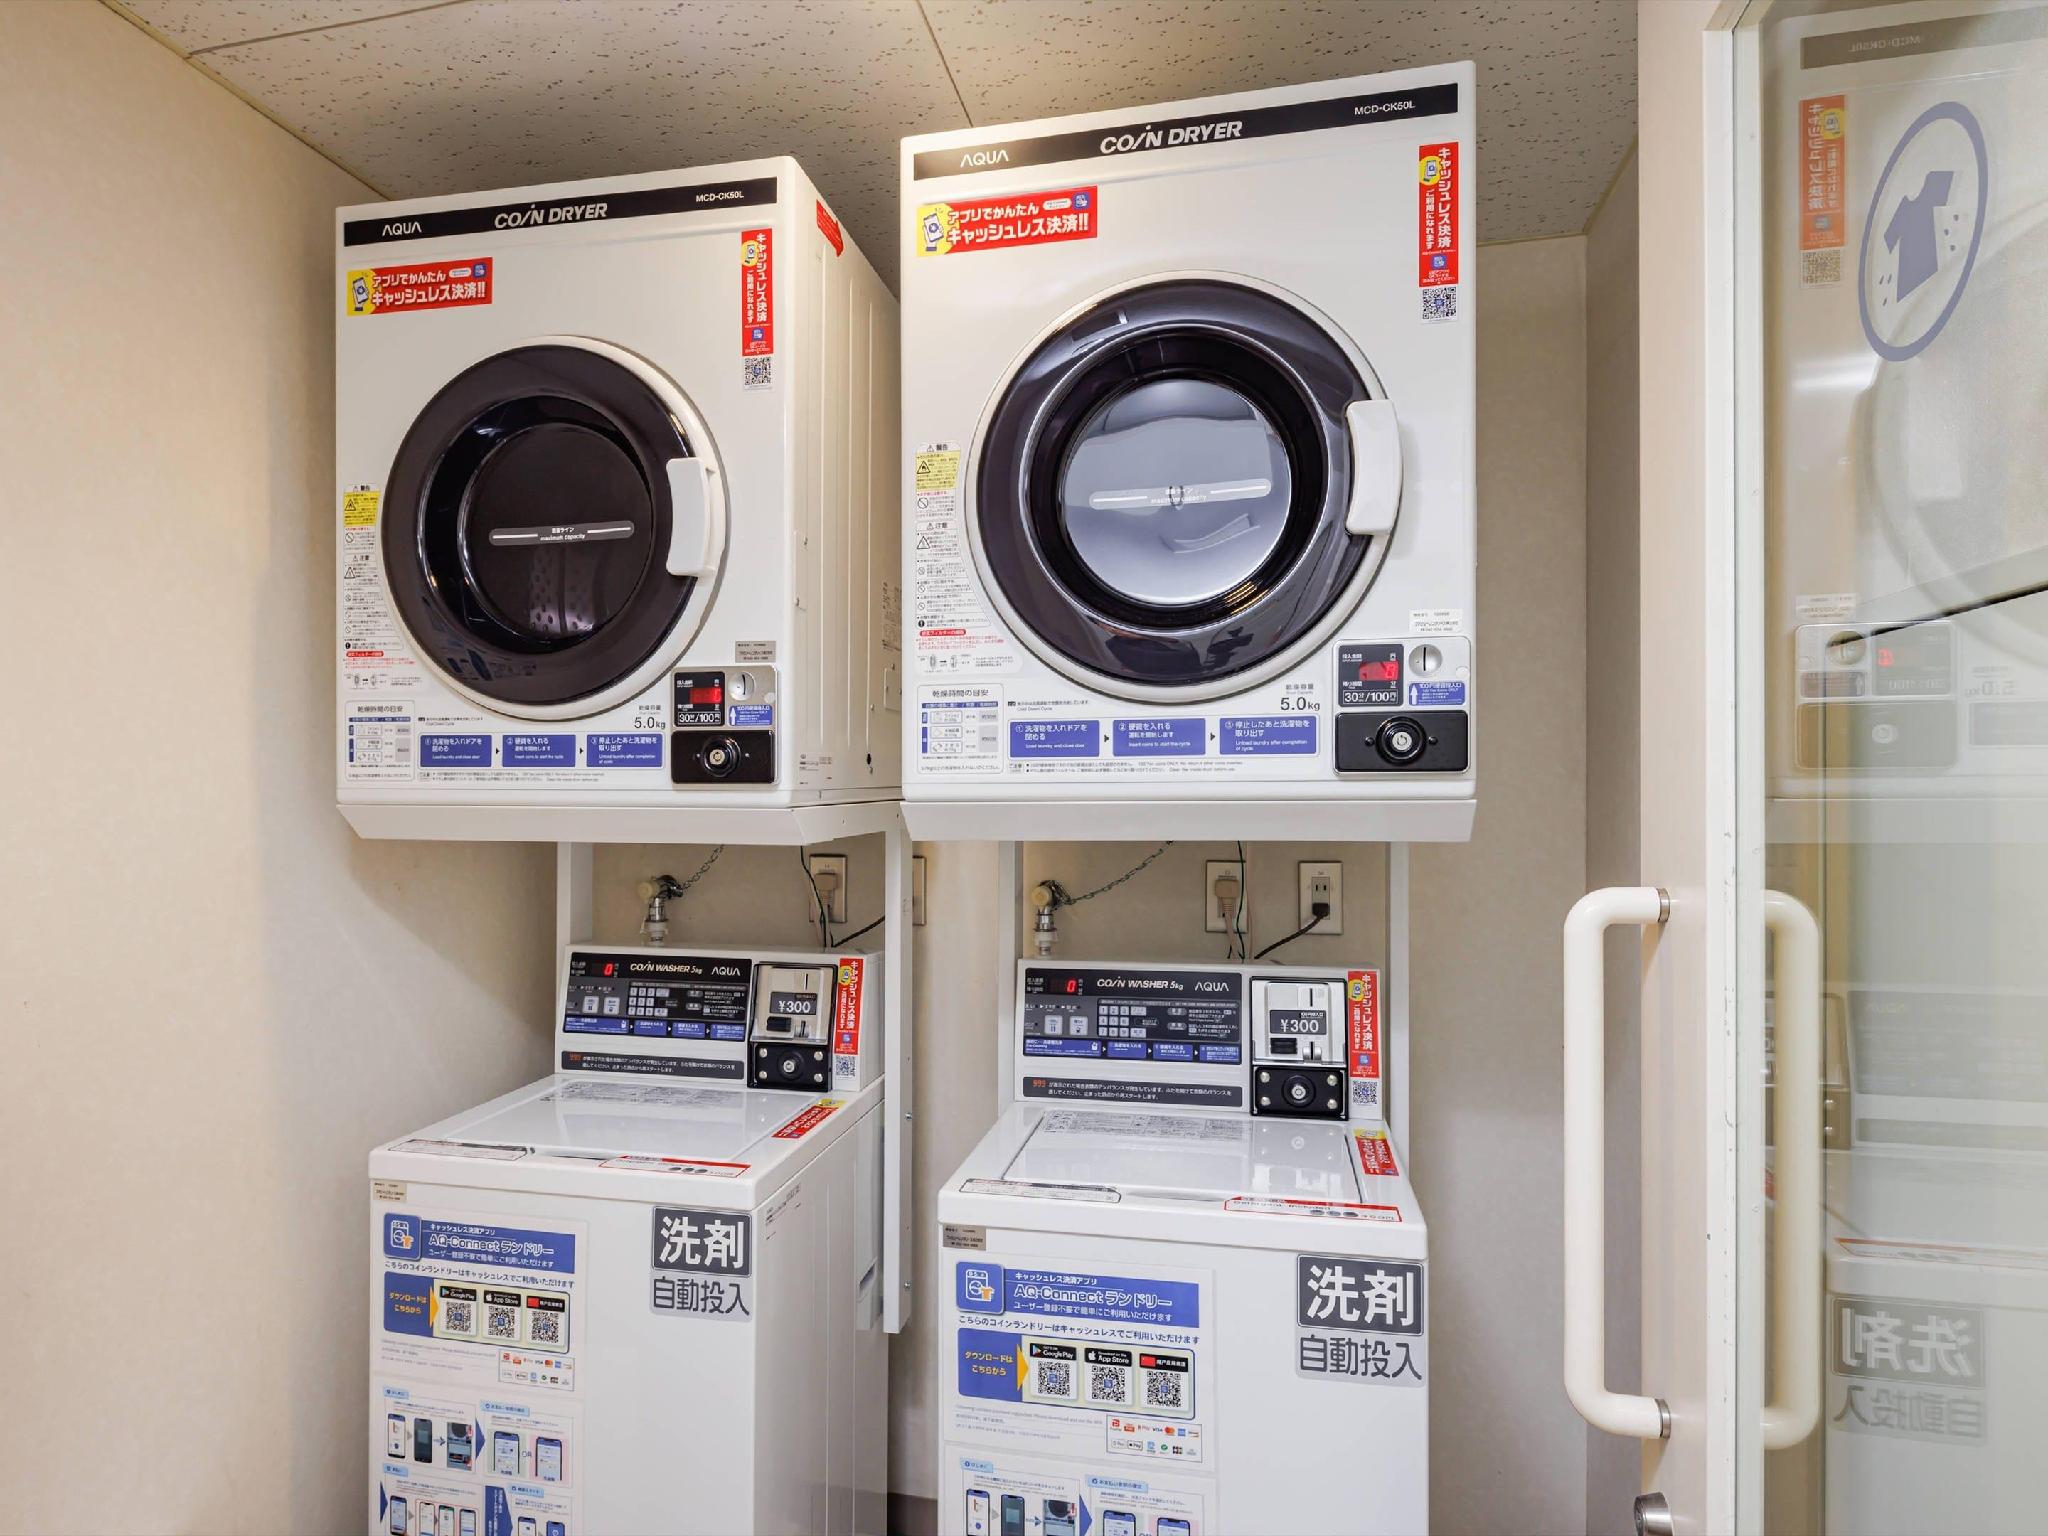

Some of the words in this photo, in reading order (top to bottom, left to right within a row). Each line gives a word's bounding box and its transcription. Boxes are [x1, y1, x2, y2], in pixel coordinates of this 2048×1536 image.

[960, 149, 1010, 168] AQUA
[1100, 124, 1163, 154] COIN
[1168, 120, 1243, 144] DRYER
[1354, 100, 1416, 115] MCD-CK50L
[1438, 147, 1452, 248] キャッシュレス決済
[382, 221, 422, 237] AQUA
[494, 203, 544, 229] COIN
[548, 202, 609, 223] DRYER
[695, 190, 745, 203] MCD-CK50L
[948, 202, 1040, 224] アプリでかんたん
[372, 270, 447, 289] アプリでかんたん
[755, 233, 768, 323] キャッシュレス決済
[1280, 696, 1321, 711] 5.0kg
[633, 716, 667, 730] 5.0kg
[604, 963, 614, 976] 0
[630, 961, 655, 972] COIN
[655, 964, 690, 973] WASHER
[711, 967, 741, 976] AQUA
[1066, 979, 1077, 993] 0
[1097, 976, 1126, 988] COIN
[1128, 980, 1169, 989] WASHER
[1194, 981, 1230, 992] AQUA
[846, 961, 859, 1029] キャッシュレス決済
[778, 1000, 811, 1014] ¥300
[1361, 974, 1373, 1050] キャッシュレス決済
[1281, 1019, 1319, 1033] ¥300
[500, 1241, 554, 1255] ランドリー
[660, 1216, 744, 1269] 洗剤
[384, 1262, 575, 1288] こちらのコインランドリーはキャッシュレスでご利用いただけます
[1015, 1273, 1097, 1285] キャッシュレス決済アプリ
[389, 1292, 427, 1304] ダウンロードは
[450, 1291, 465, 1299] Google
[505, 1297, 519, 1305] Store
[654, 1276, 750, 1316] 自動投入
[1014, 1284, 1104, 1303] AQ-Connect
[1105, 1290, 1173, 1308] ランドリー
[1307, 1265, 1414, 1327] 洗剤
[394, 1304, 422, 1314] こちらから
[1014, 1302, 1173, 1322] ユーザー登録不要で簡単にご利用いただけます
[959, 1315, 1200, 1344] こちらのコインランドリーはキャッシュレスでご利用いただけます
[965, 1351, 1014, 1363] ダウンロードは
[1042, 1349, 1062, 1359] Google
[1062, 1351, 1074, 1360] Play
[1098, 1354, 1111, 1363] App
[1112, 1356, 1130, 1364] Store
[1300, 1334, 1423, 1380] 自動投入
[971, 1364, 1007, 1376] こちらから
